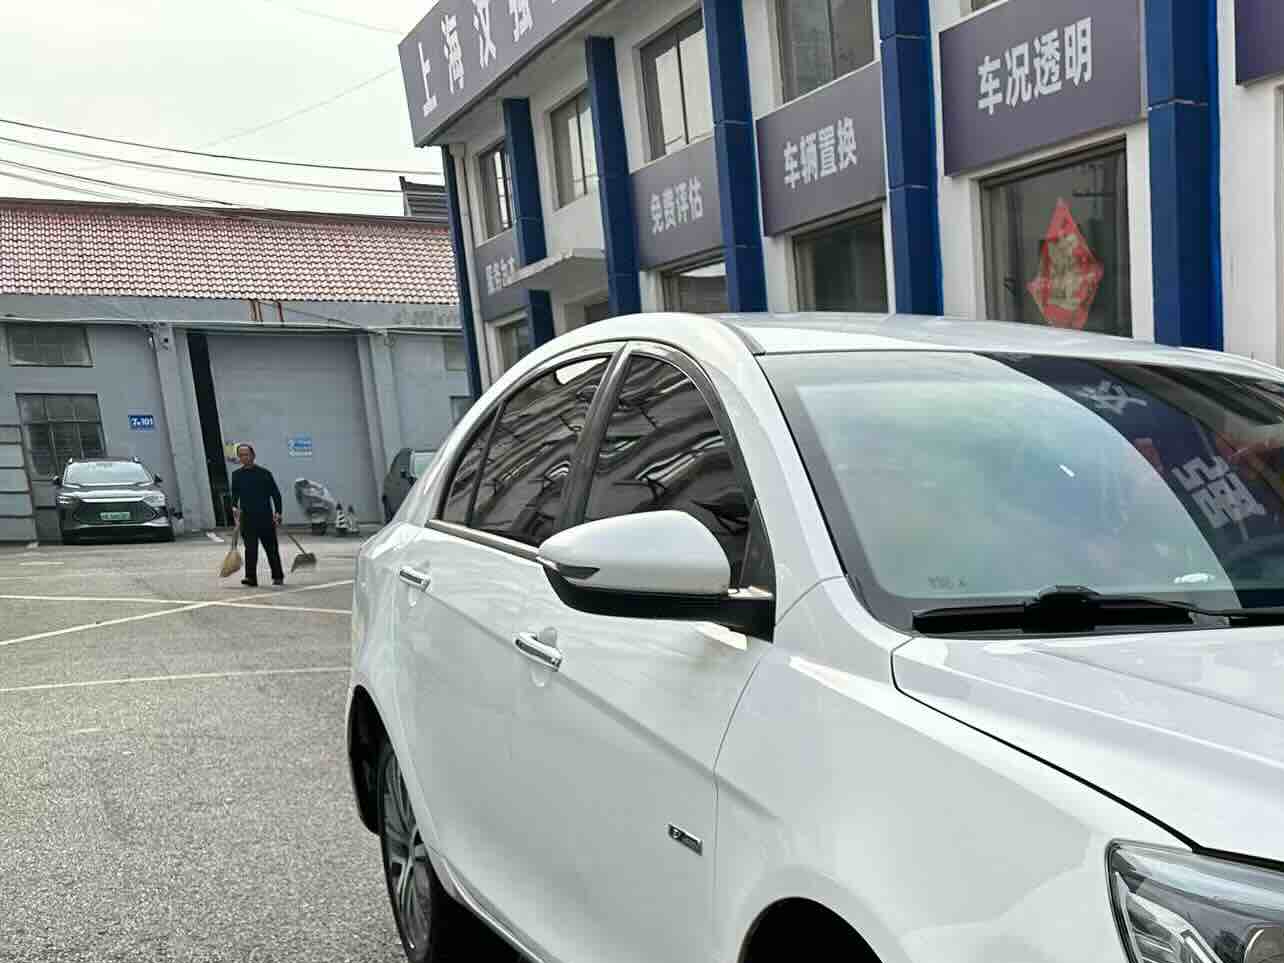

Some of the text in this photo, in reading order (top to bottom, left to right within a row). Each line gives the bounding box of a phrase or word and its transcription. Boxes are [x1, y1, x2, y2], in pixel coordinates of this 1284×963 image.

[977, 17, 1093, 114] 车况透明
[783, 116, 857, 188] 车辆置换
